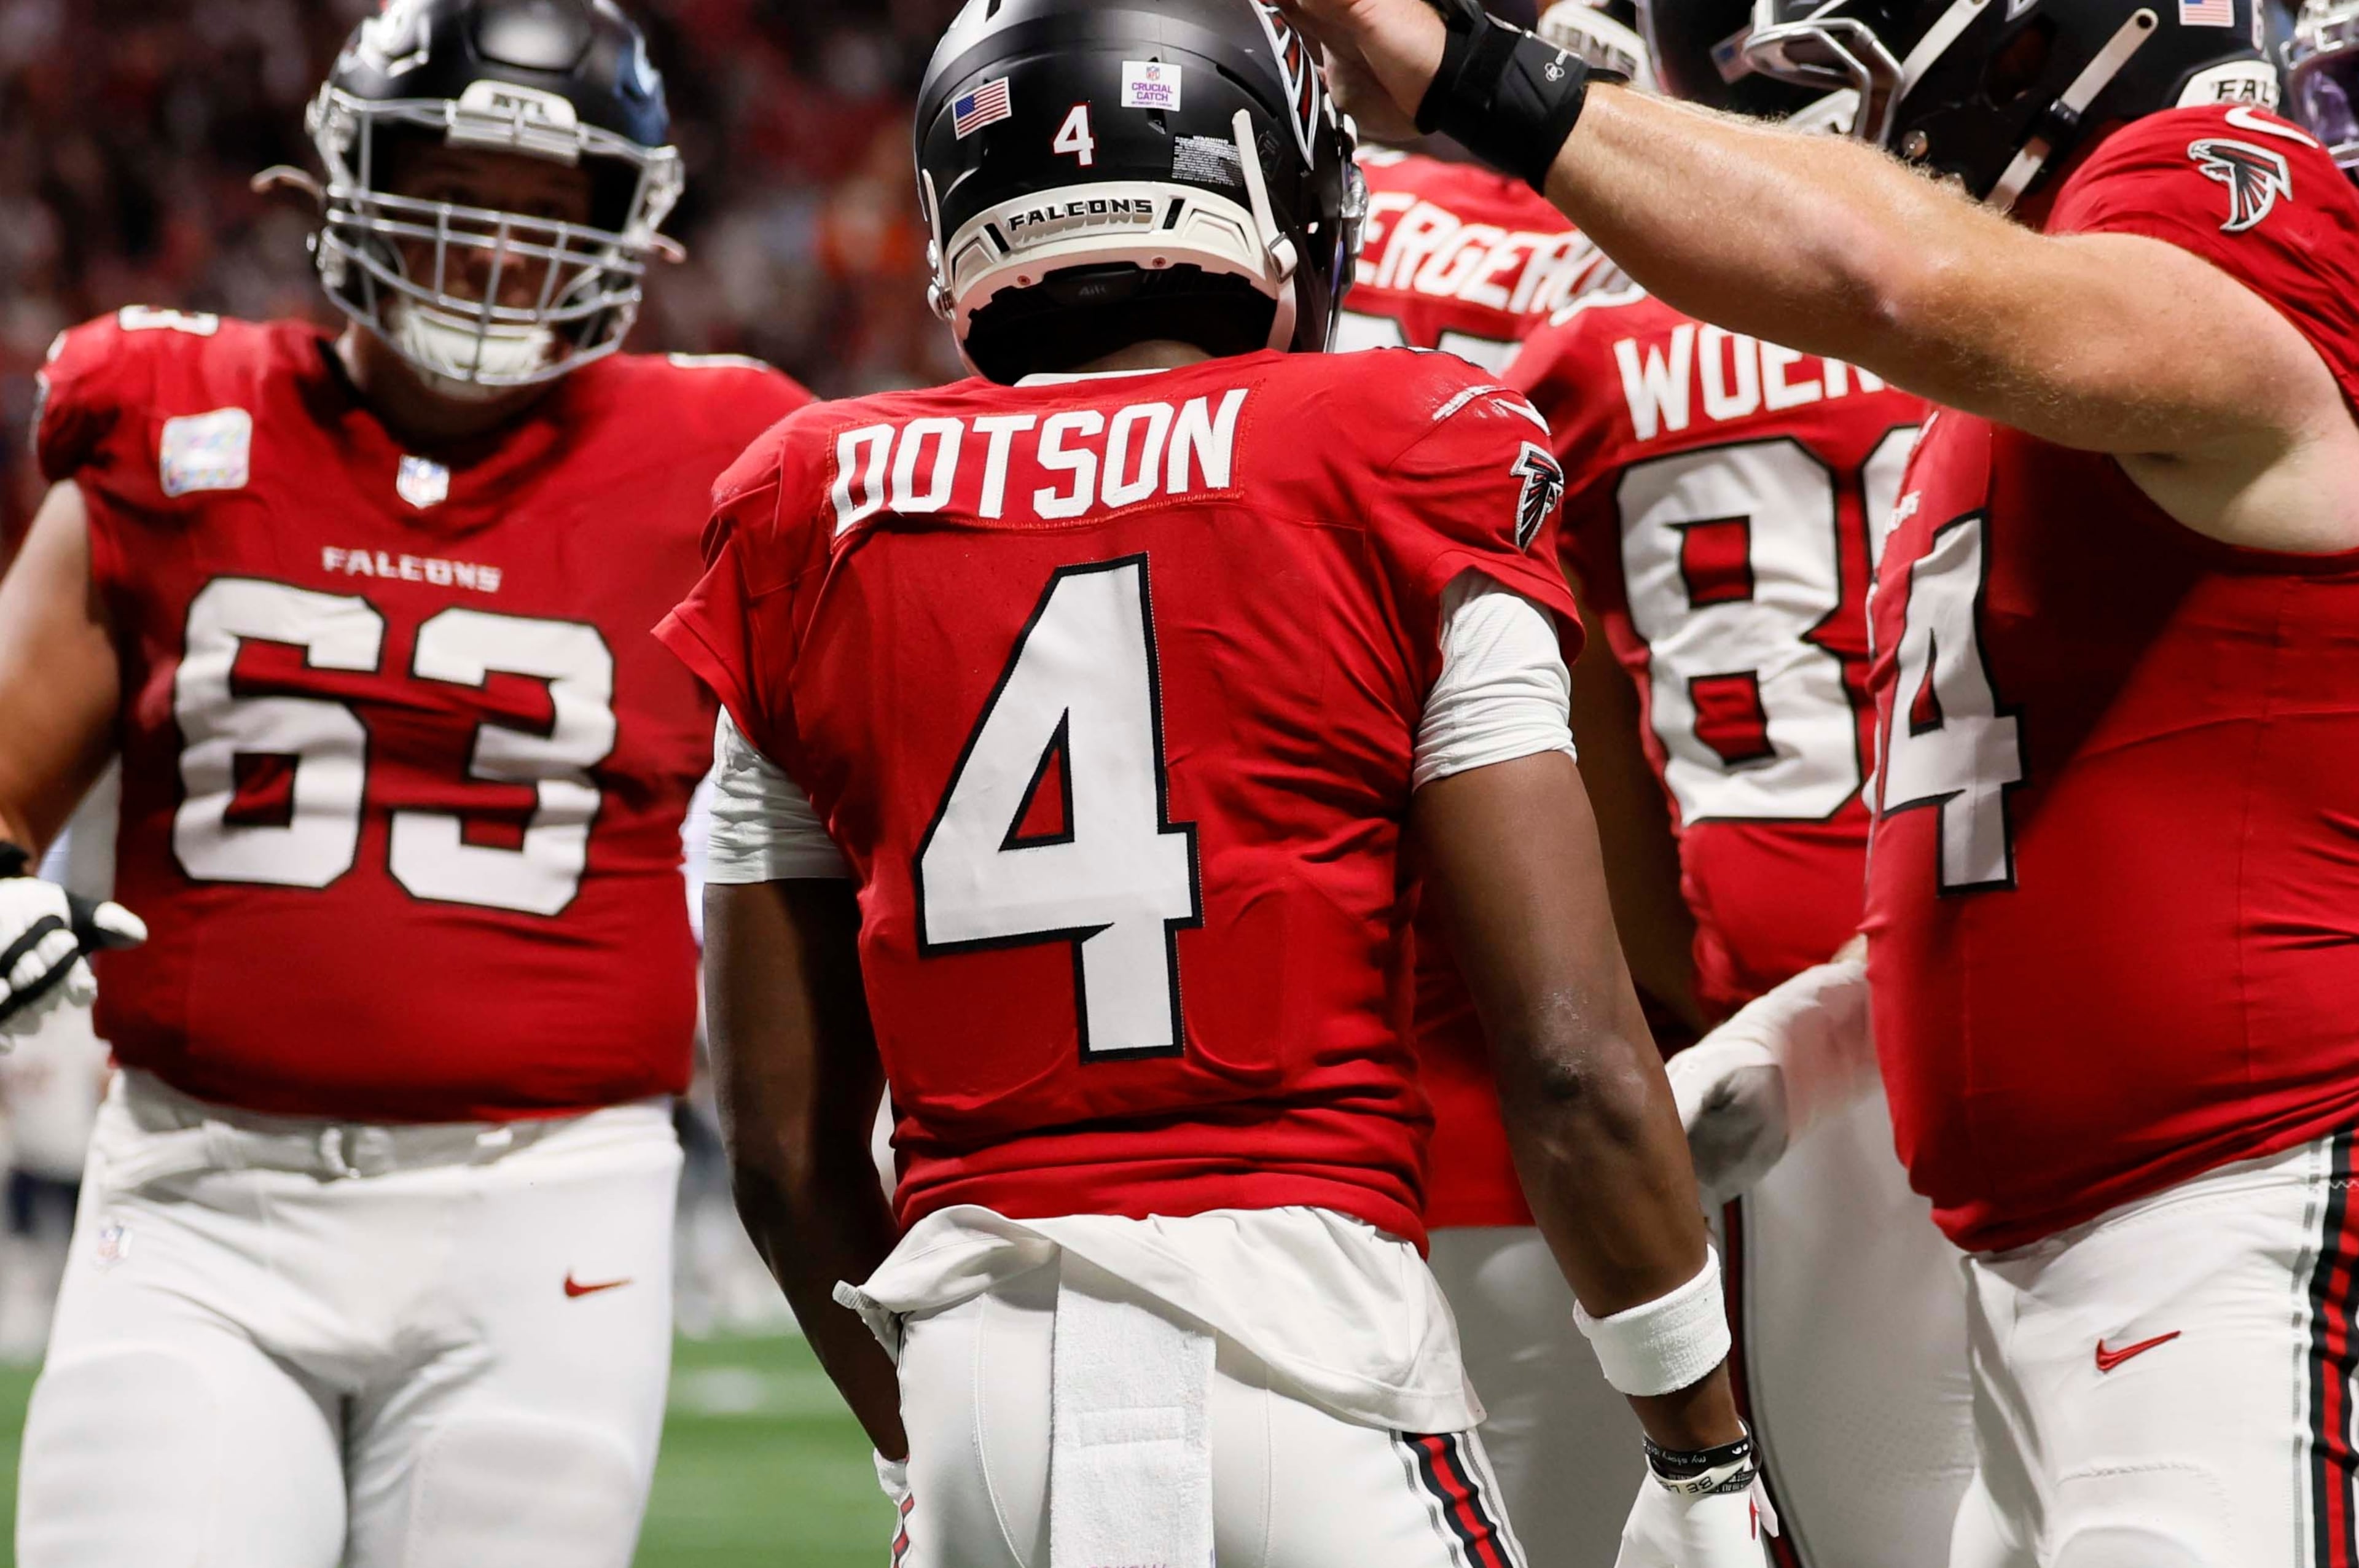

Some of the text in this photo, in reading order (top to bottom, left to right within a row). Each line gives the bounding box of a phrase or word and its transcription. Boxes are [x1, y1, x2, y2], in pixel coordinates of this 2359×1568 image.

[1131, 82, 1173, 94] CRUCIAL
[1136, 92, 1169, 102] CATCH
[1051, 103, 1095, 167] 4
[1192, 135, 1229, 145] WARNING
[1007, 198, 1153, 232] FALCONS
[831, 388, 1249, 537] DOTSON
[322, 545, 503, 594] FALCONS
[1865, 507, 2030, 899] 4
[173, 575, 617, 917] 63
[912, 551, 1205, 1065] 4
[1685, 1476, 1715, 1494] BE
